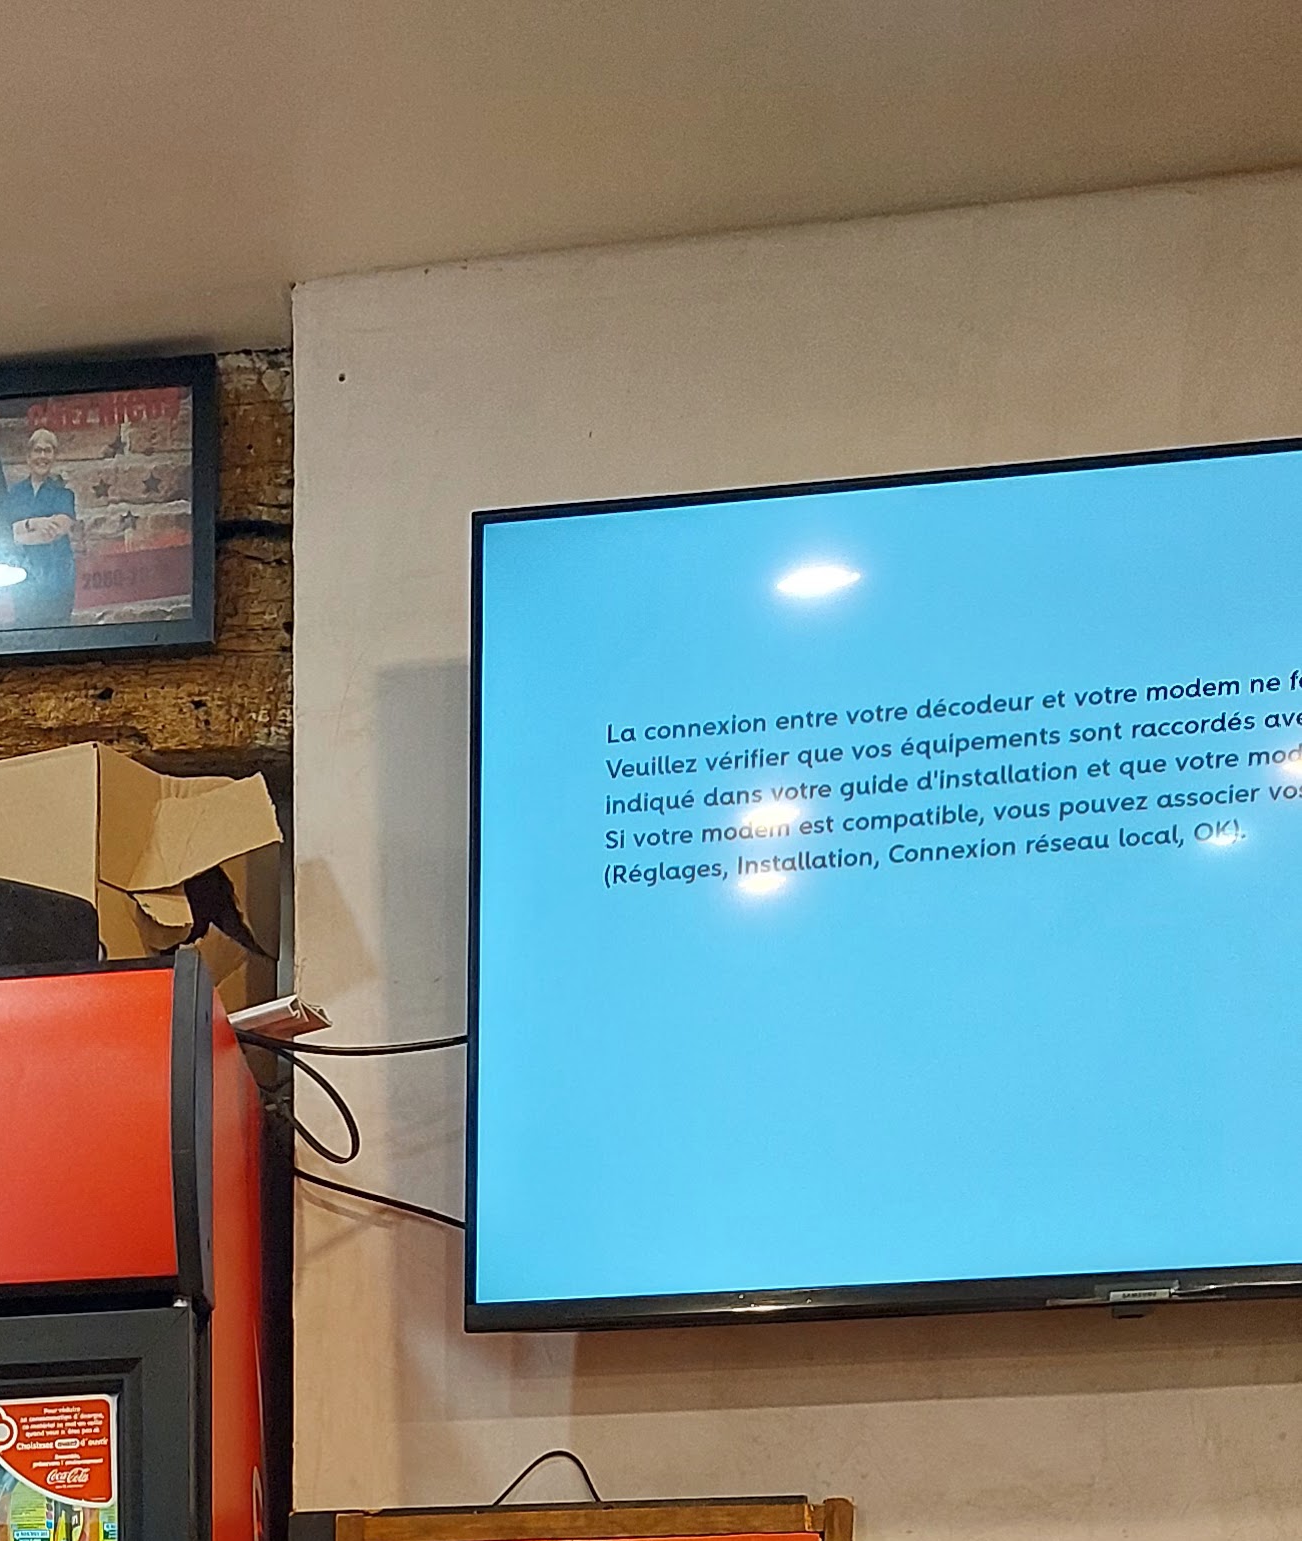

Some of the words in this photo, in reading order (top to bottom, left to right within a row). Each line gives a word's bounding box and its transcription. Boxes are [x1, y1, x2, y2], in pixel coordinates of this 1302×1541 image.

[606, 723, 636, 744] La
[644, 714, 766, 741] connexion
[775, 709, 838, 730] entre
[846, 704, 908, 725] votre
[916, 692, 1035, 720] décodeur
[1042, 689, 1066, 709] et
[1075, 686, 1138, 707] votre
[1146, 677, 1240, 702] modem
[1250, 676, 1281, 693] ne
[1289, 669, 1302, 691] f
[605, 755, 698, 780] Veuillez
[705, 748, 790, 772] vérifier
[797, 745, 844, 768] que
[851, 740, 892, 760] vos
[900, 727, 1061, 758] équipements
[1069, 721, 1122, 744] sont
[1131, 710, 1255, 739] raccordés
[605, 788, 695, 816] indiqué
[703, 785, 763, 807] dans
[770, 781, 832, 803] votre
[840, 772, 909, 801] guide
[916, 761, 1077, 791] d'installation
[1086, 758, 1110, 778] et
[1119, 756, 1167, 780] que
[1175, 749, 1239, 773] votre
[605, 829, 626, 850] Si
[632, 824, 694, 847] votre
[701, 819, 791, 844] modem
[798, 813, 835, 836] est
[842, 803, 986, 834] compatible,
[993, 798, 1051, 821] vous
[1058, 794, 1149, 822] pouvez
[1156, 784, 1261, 810] associer
[1268, 785, 1302, 801] vo
[604, 861, 730, 889] (Réglages,
[736, 848, 881, 876] Installation,
[888, 837, 1016, 865] Connexion
[1025, 833, 1110, 856] réseau
[1118, 823, 1185, 849] local,
